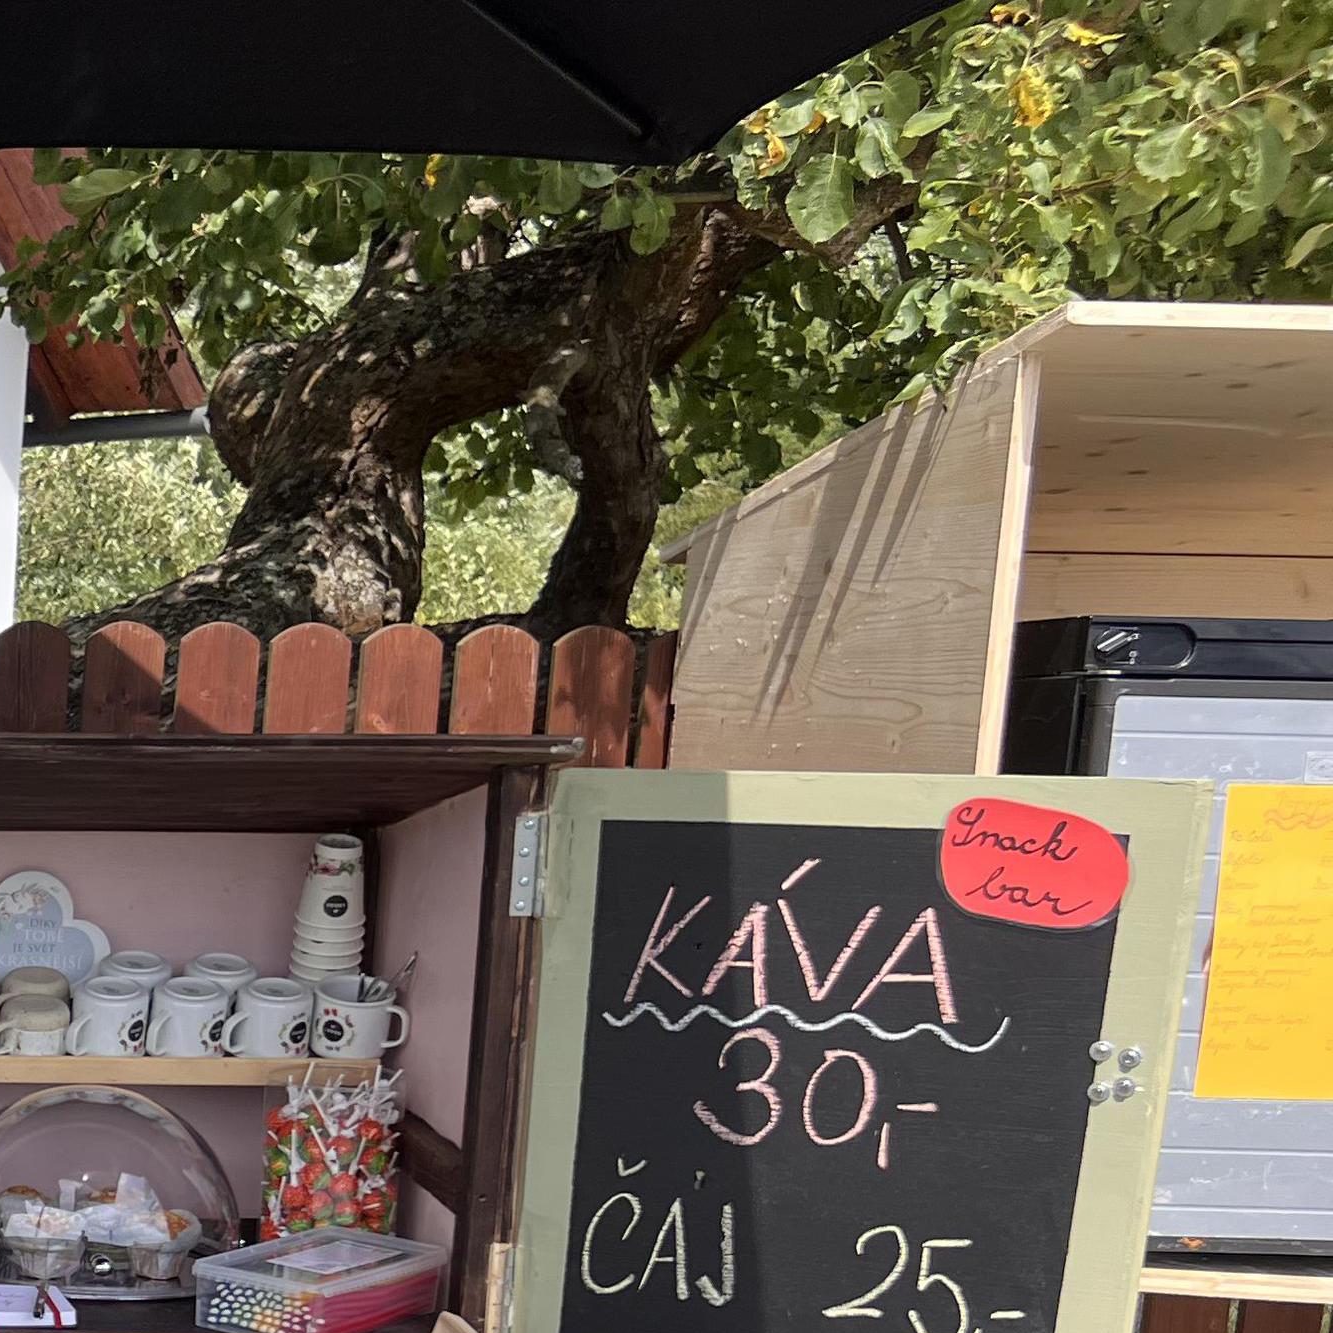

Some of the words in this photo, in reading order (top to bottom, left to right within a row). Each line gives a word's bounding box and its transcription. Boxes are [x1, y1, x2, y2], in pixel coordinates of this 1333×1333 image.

[950, 807, 1078, 862] Snack
[965, 866, 1093, 916] bar
[624, 858, 959, 1023] KÁVA
[693, 1027, 940, 1170] 30,-
[581, 1157, 734, 1307] ČAJ
